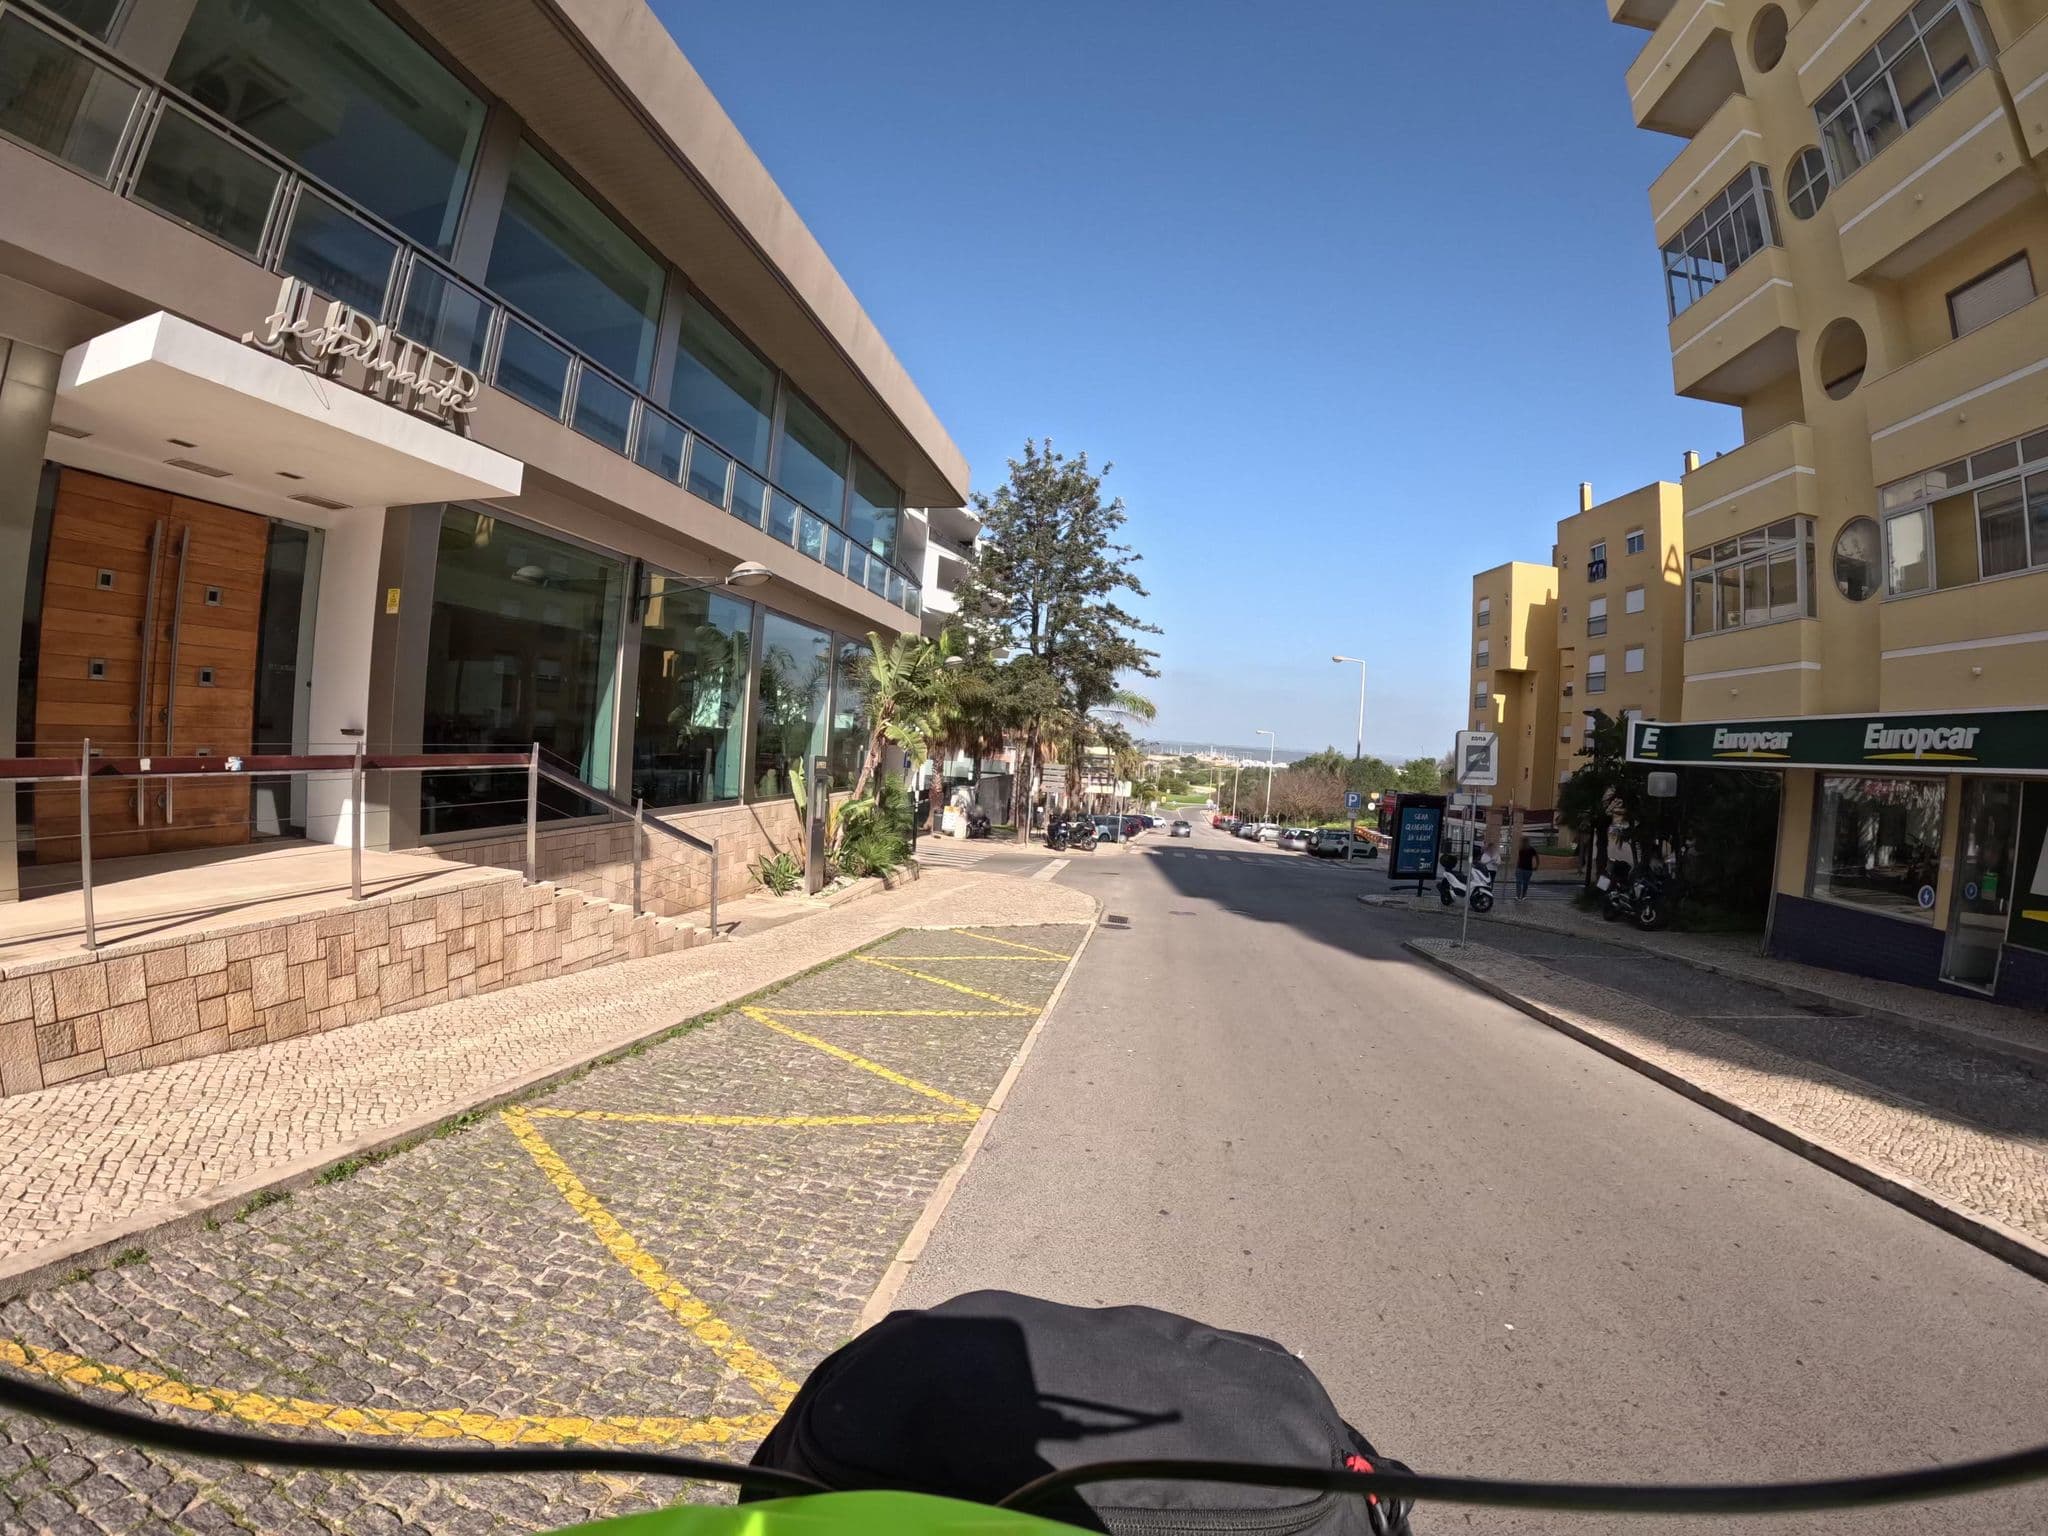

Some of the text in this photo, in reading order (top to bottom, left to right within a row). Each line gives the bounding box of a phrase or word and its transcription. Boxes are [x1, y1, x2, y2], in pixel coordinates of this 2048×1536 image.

[1641, 728, 1661, 750] E
[1713, 728, 1793, 757] Europcar
[1864, 723, 1980, 760] Europcar
[1348, 794, 1358, 807] P
